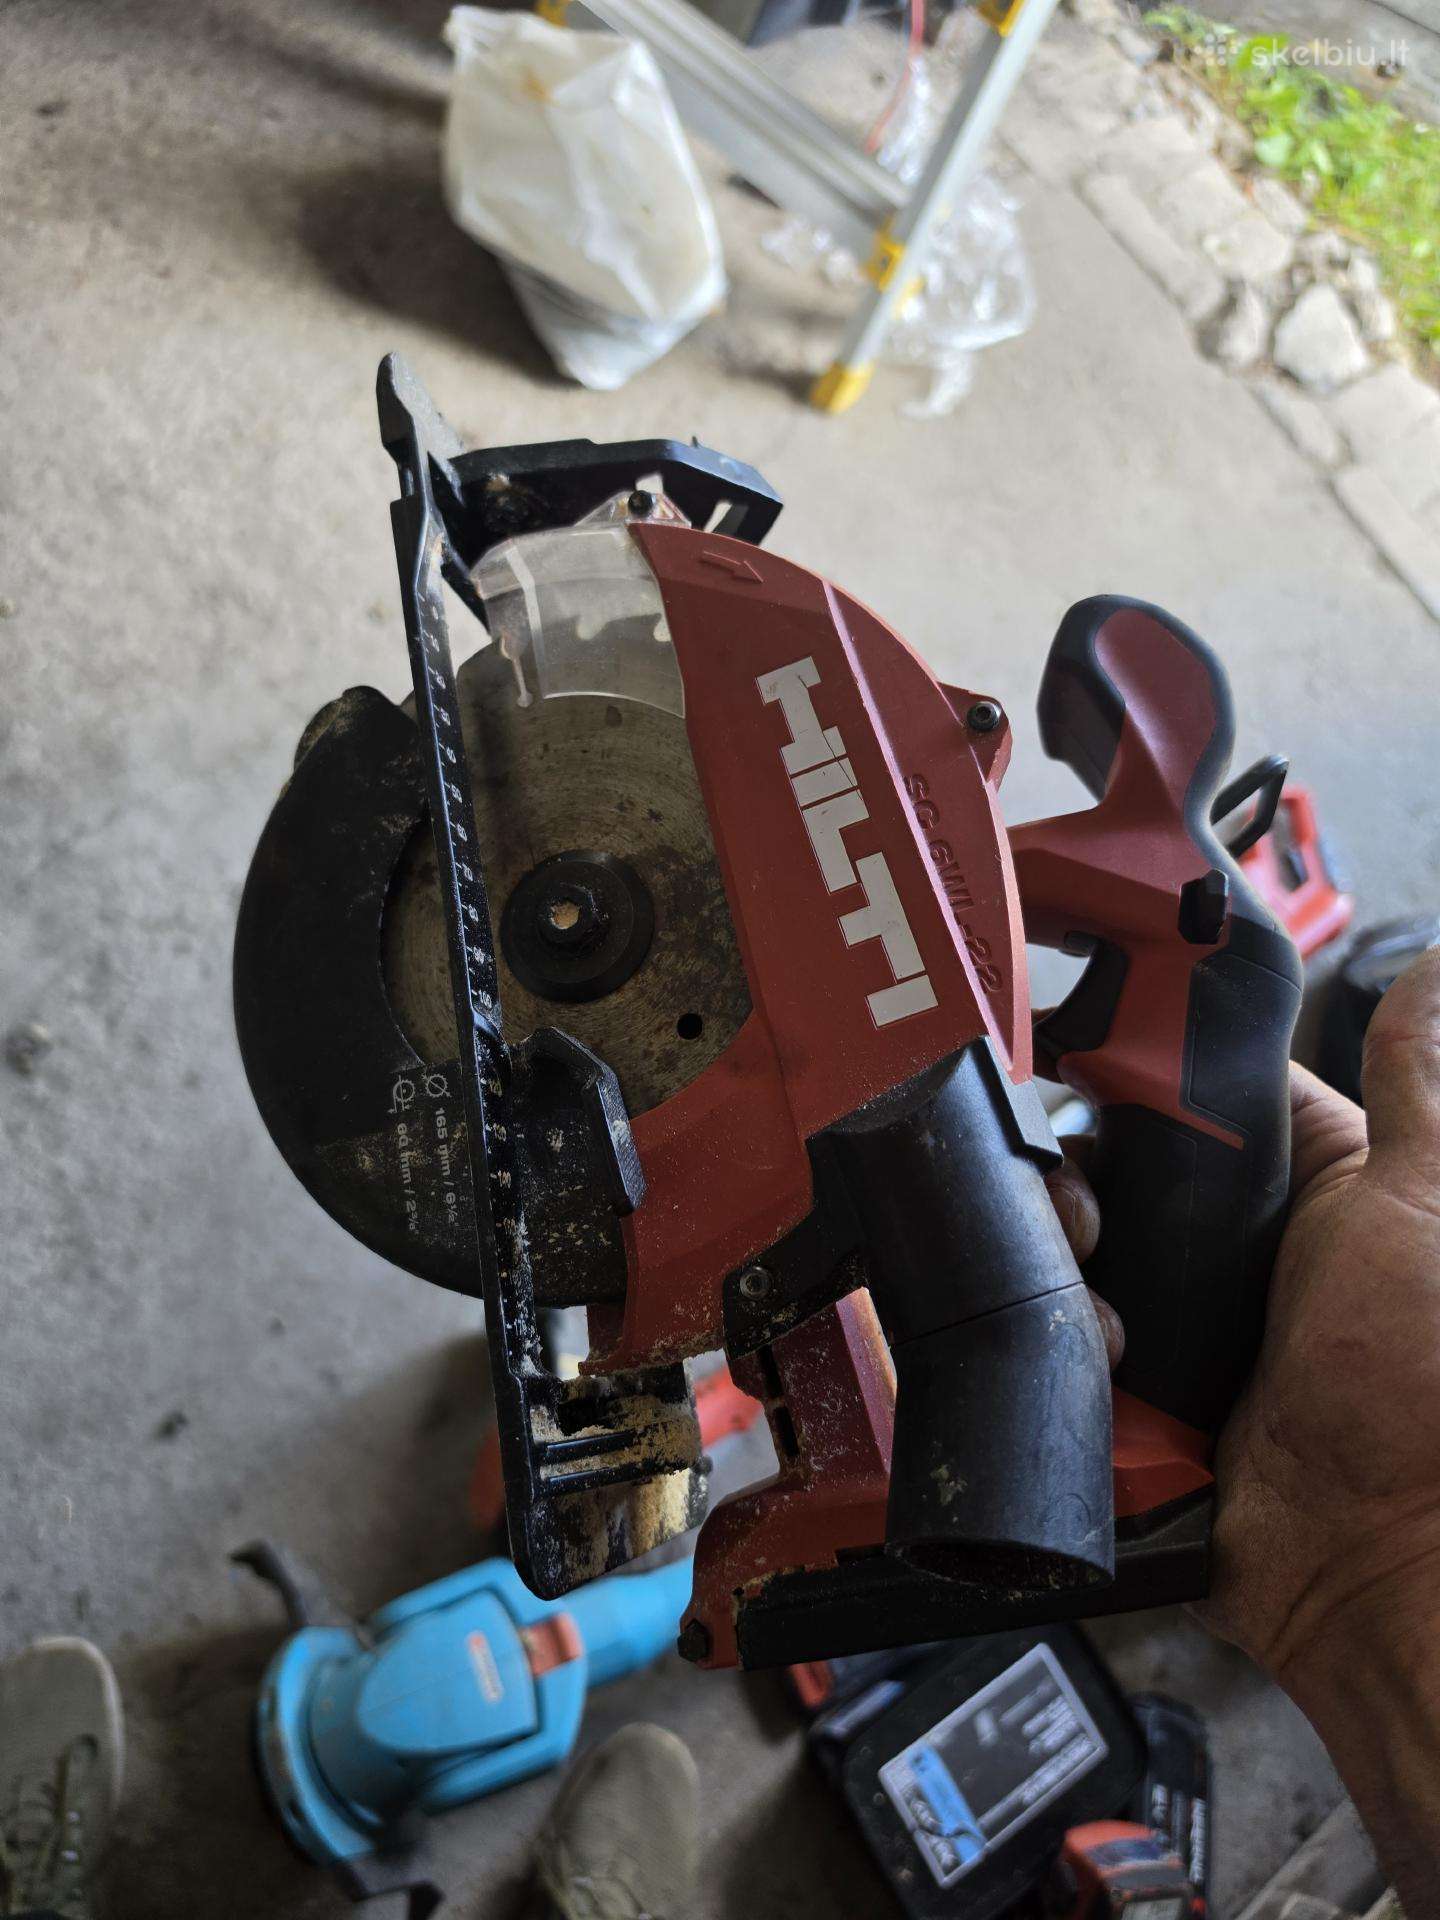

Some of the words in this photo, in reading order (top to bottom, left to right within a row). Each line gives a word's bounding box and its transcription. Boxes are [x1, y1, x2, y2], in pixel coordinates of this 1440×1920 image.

[903, 774, 940, 832] SC
[755, 655, 939, 1031] HILTI
[435, 1107, 449, 1140] 165
[400, 1150, 412, 1184] mm
[438, 1144, 451, 1177] mm
